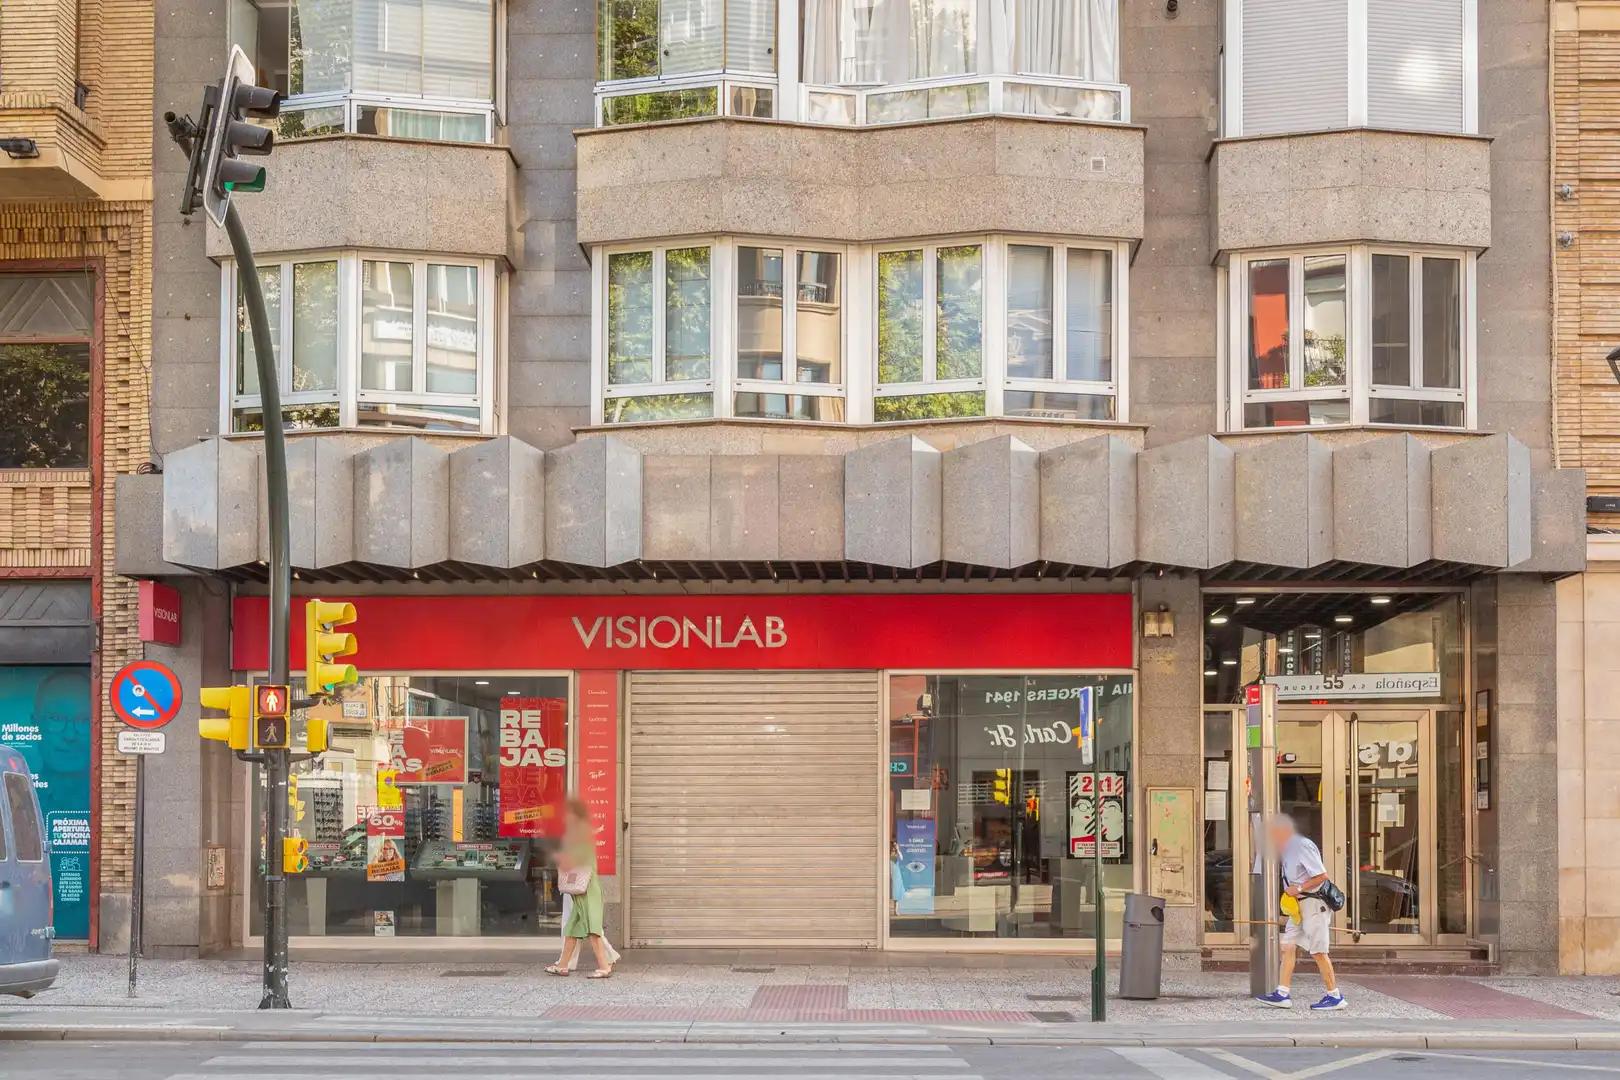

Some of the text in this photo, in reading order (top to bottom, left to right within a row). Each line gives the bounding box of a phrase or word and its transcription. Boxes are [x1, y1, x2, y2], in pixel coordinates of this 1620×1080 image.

[153, 607, 177, 622] VISIONLAB
[571, 615, 788, 649] VISIONLAB
[1323, 675, 1344, 689] 55
[500, 710, 541, 728] RE
[1, 723, 39, 733] Millones
[2, 732, 43, 741] de socios
[500, 729, 545, 747] BA
[500, 748, 565, 767] JAS
[52, 817, 88, 826] PRÓXIMA
[371, 865, 401, 874] REBAJAS
